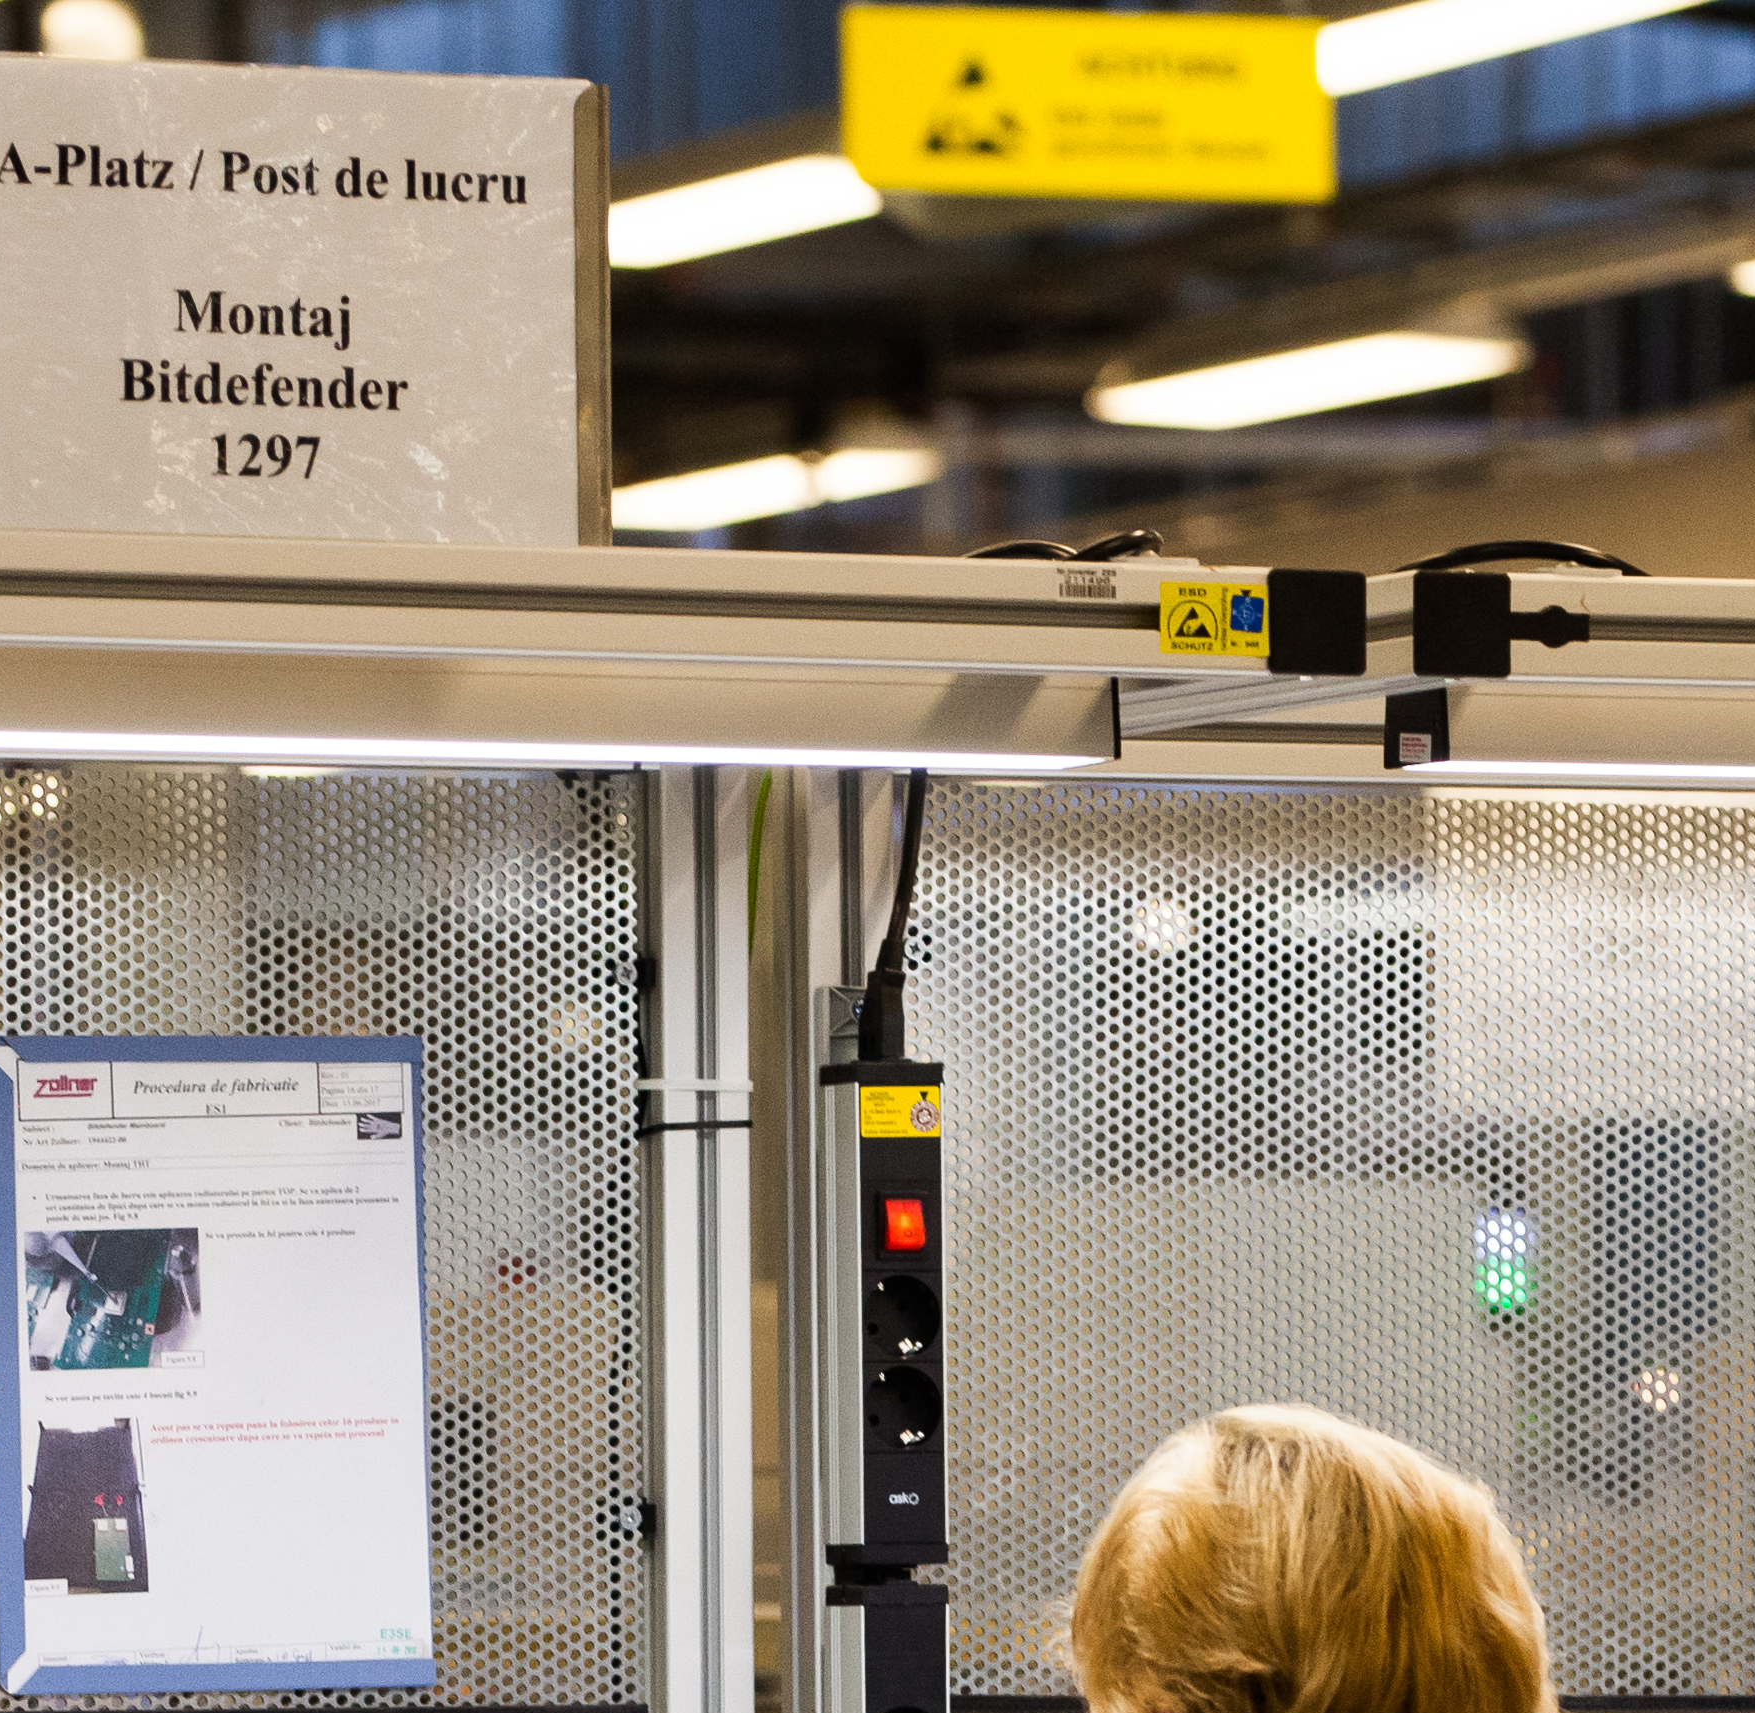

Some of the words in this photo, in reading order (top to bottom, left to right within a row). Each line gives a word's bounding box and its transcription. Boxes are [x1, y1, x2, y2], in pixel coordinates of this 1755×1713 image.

[187, 148, 205, 191] /
[220, 150, 320, 197] Post
[333, 156, 391, 201] de
[403, 160, 530, 206] lucru
[174, 289, 353, 350] Montaj
[119, 359, 409, 411] Bitdefender
[211, 434, 321, 481] 1297
[1178, 586, 1207, 597] ESD
[133, 1082, 207, 1094] Procedura
[211, 1080, 227, 1093] de
[231, 1079, 299, 1092] fabricatie
